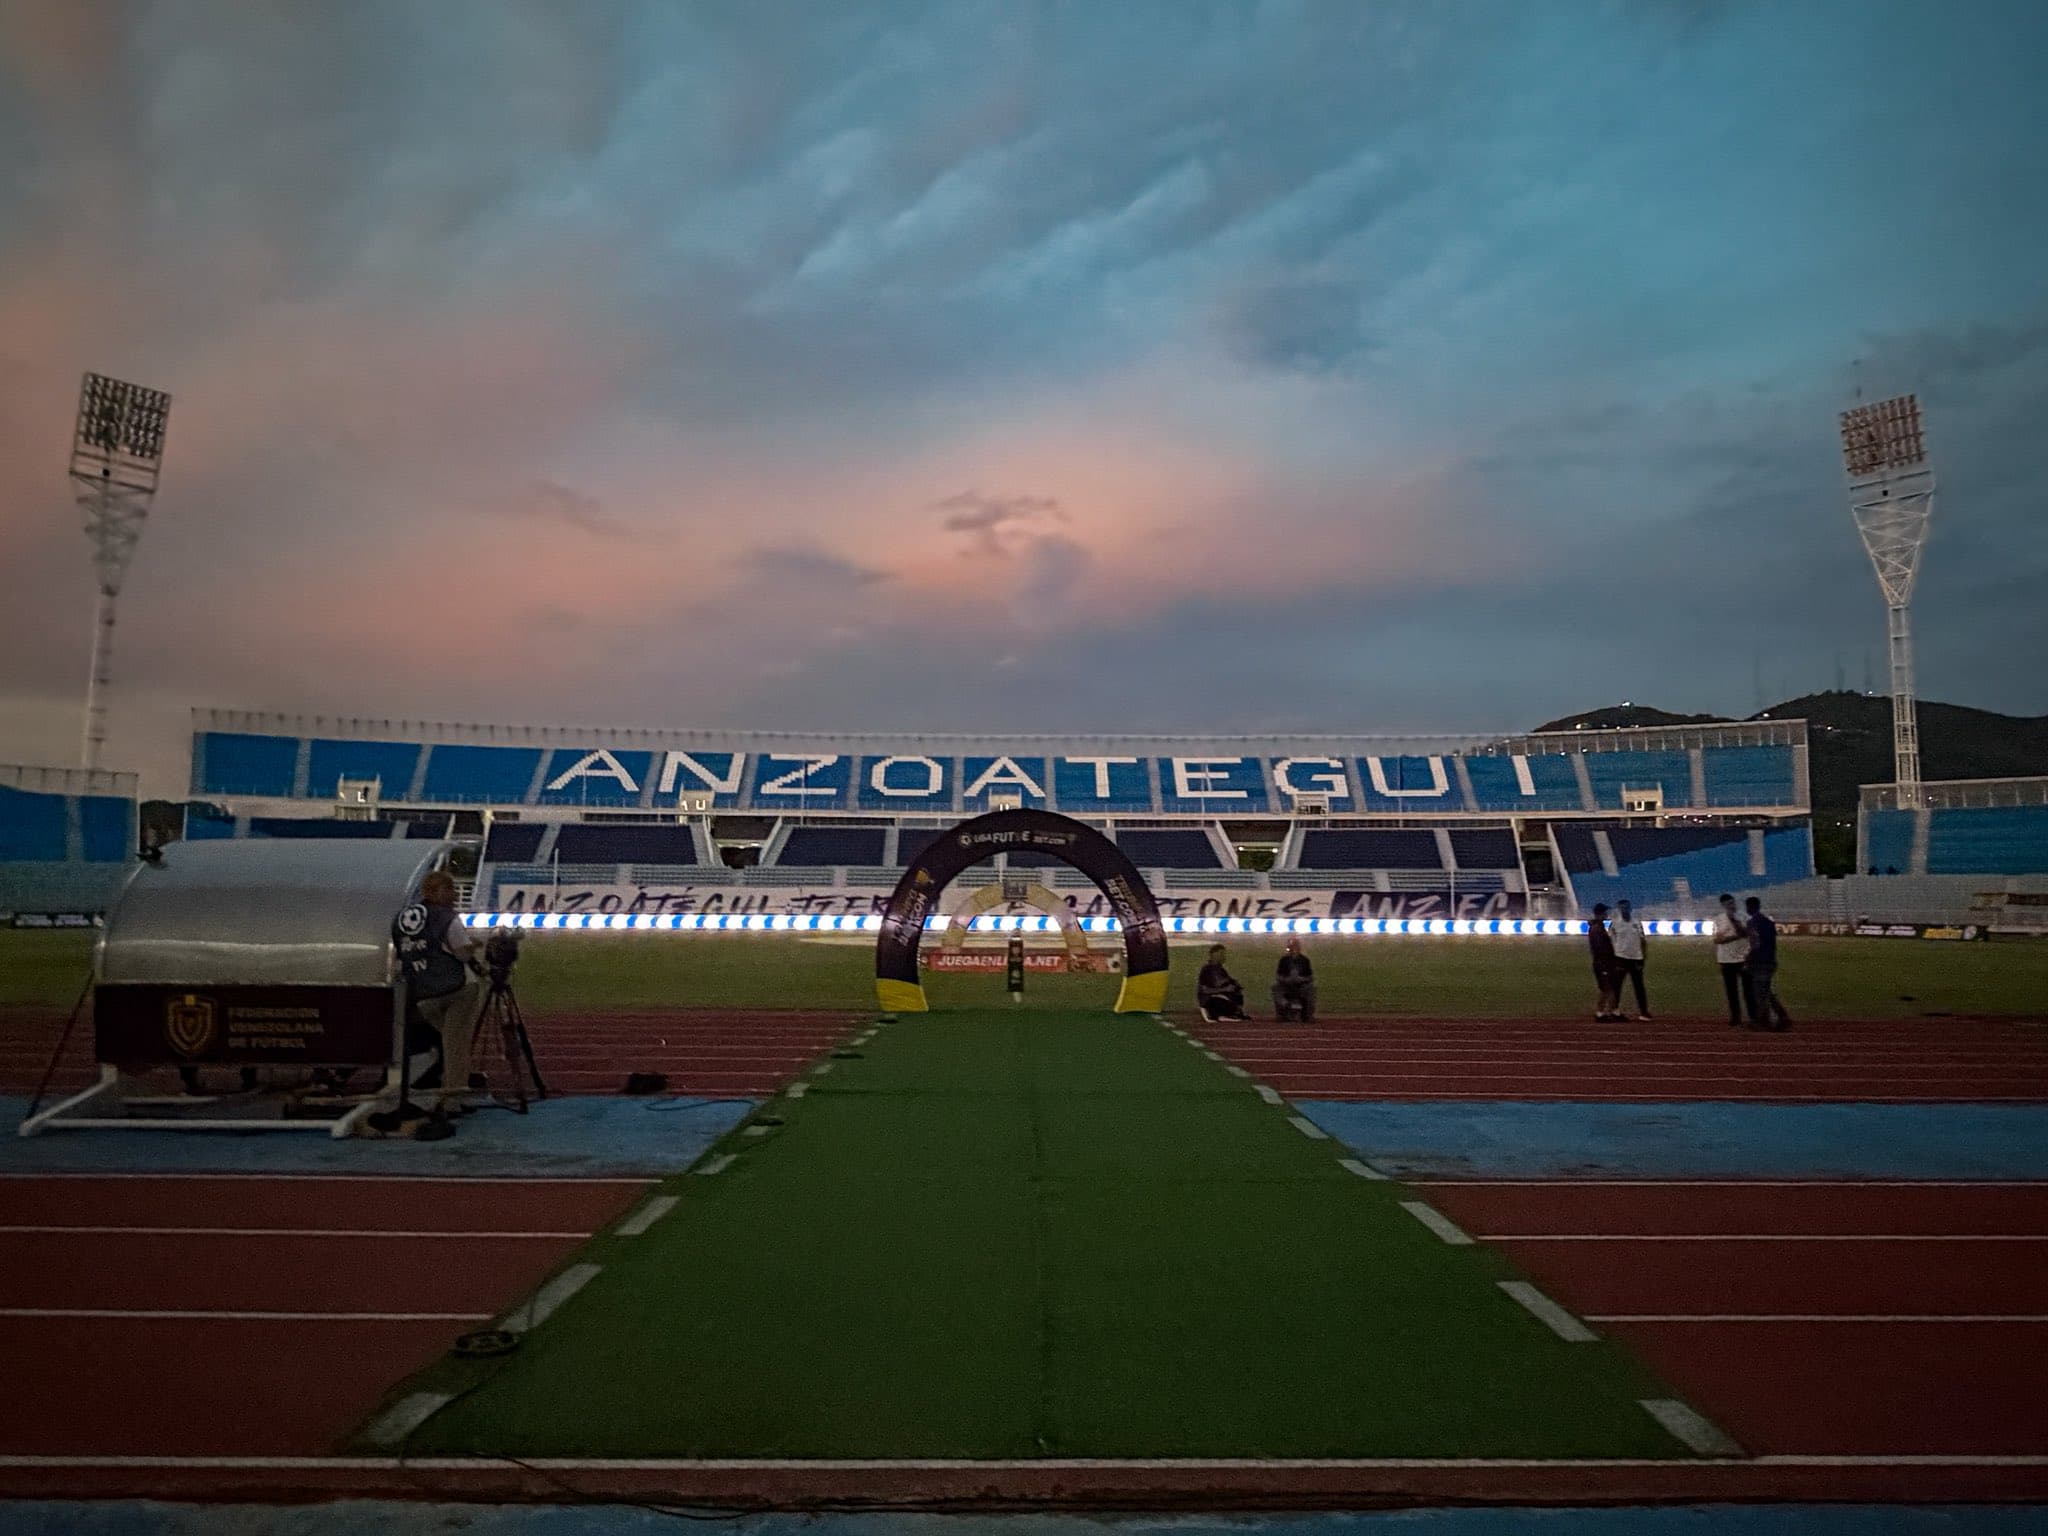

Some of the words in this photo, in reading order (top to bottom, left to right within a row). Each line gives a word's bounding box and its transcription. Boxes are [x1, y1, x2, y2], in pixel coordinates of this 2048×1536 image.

[547, 748, 1537, 798] ANZOATEGUI
[993, 830, 1031, 843] FUTE
[937, 955, 1062, 967] JUEGAENLIA.NET
